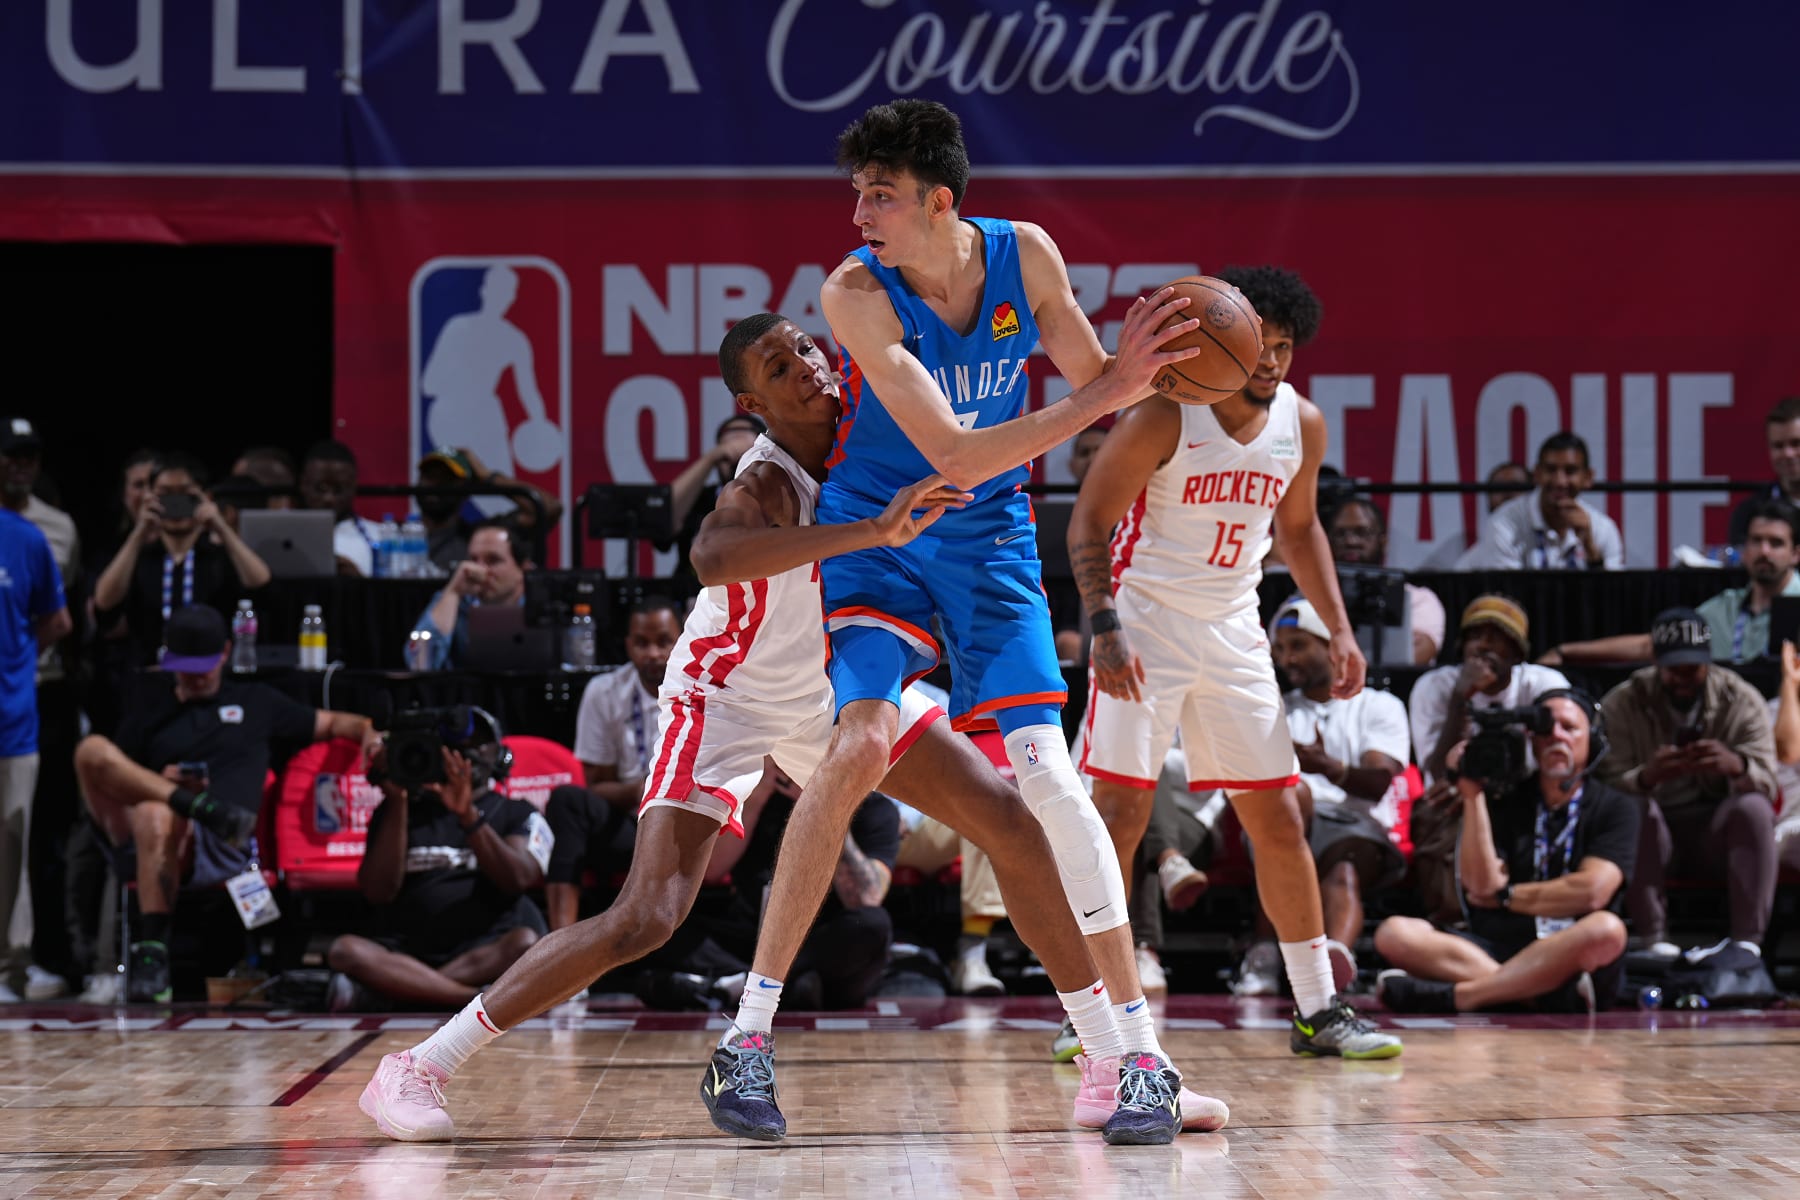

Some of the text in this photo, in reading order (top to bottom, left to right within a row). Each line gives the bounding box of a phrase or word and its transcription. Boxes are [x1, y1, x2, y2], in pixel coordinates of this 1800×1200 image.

[766, 0, 1360, 140] Courtside
[932, 357, 1026, 404] UNDER
[1182, 470, 1284, 510] ROCKETS
[1309, 371, 1734, 569] EAGUE
[1207, 520, 1247, 569] 15
